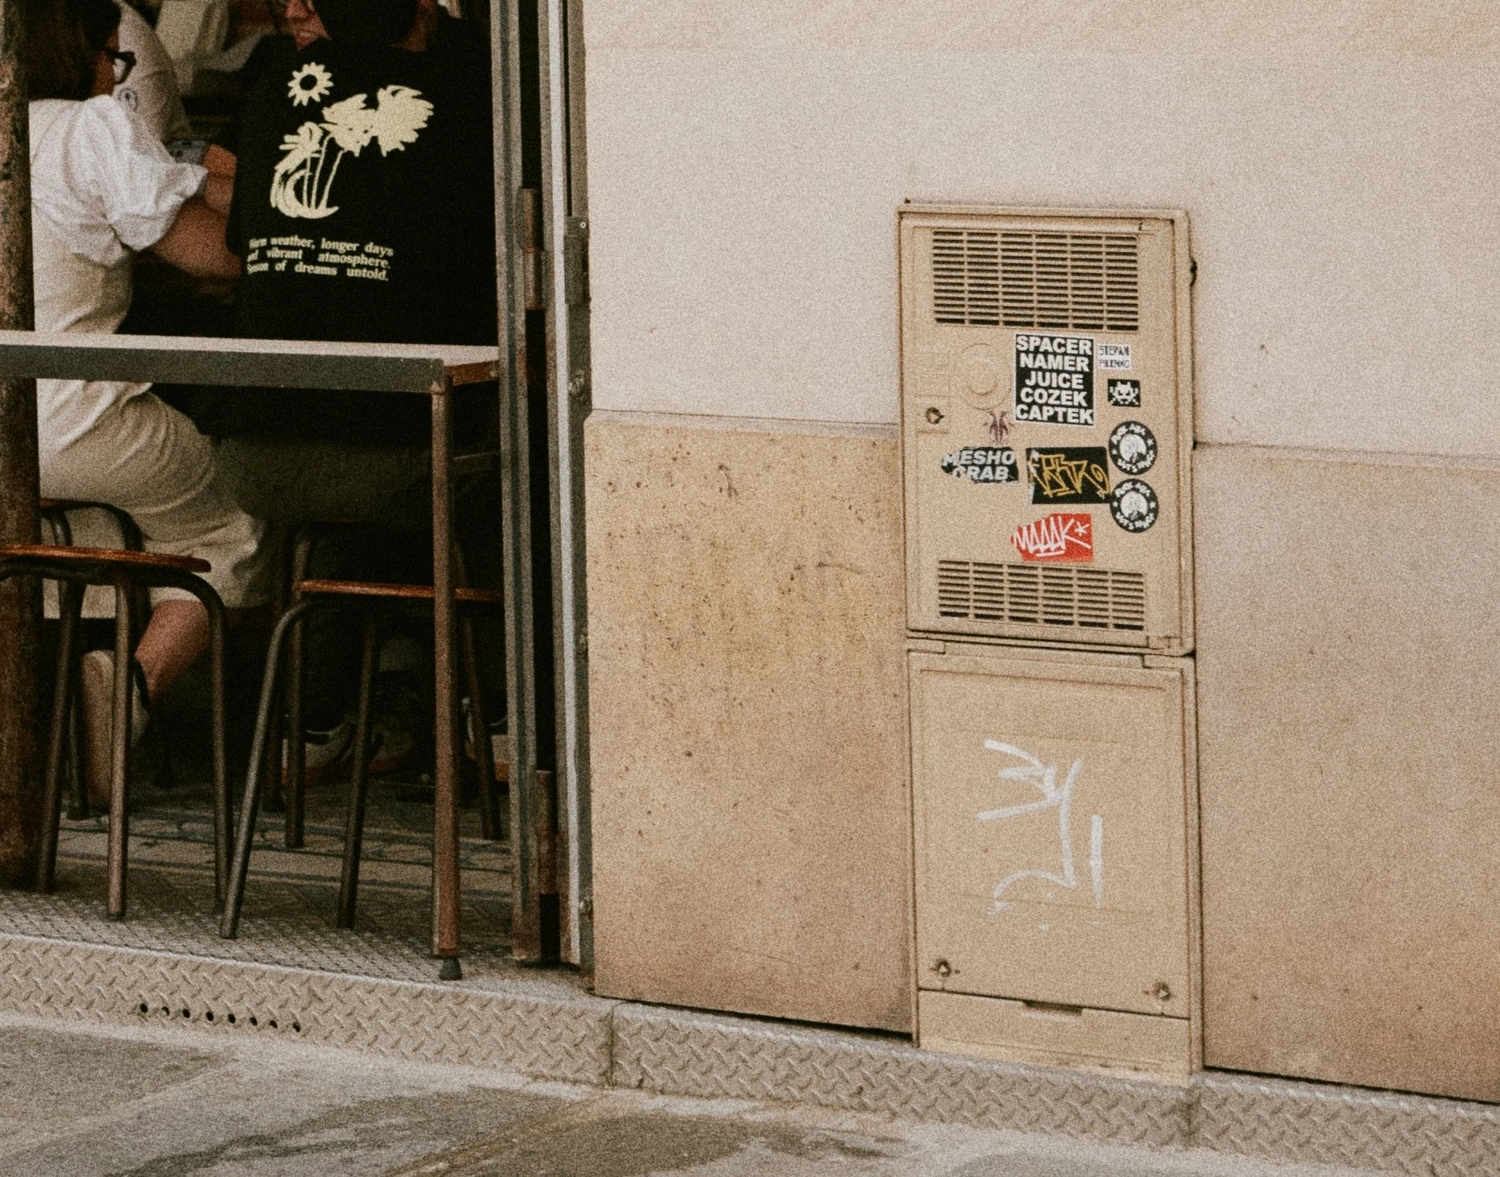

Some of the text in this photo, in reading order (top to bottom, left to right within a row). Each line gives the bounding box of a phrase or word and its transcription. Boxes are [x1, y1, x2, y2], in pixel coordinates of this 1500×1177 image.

[270, 234, 315, 250] weather,
[320, 237, 360, 253] longer
[364, 241, 394, 258] days
[266, 247, 303, 260] vibrant
[317, 251, 391, 270] atmosphere.
[274, 259, 288, 271] of
[294, 261, 338, 277] dreams
[346, 267, 390, 282] untold.
[1016, 335, 1093, 356] SPACER
[1019, 353, 1090, 372] NAMER
[1025, 372, 1085, 390] JUICE
[1020, 388, 1088, 408] COZEK
[1016, 404, 1095, 425] CAPTEK
